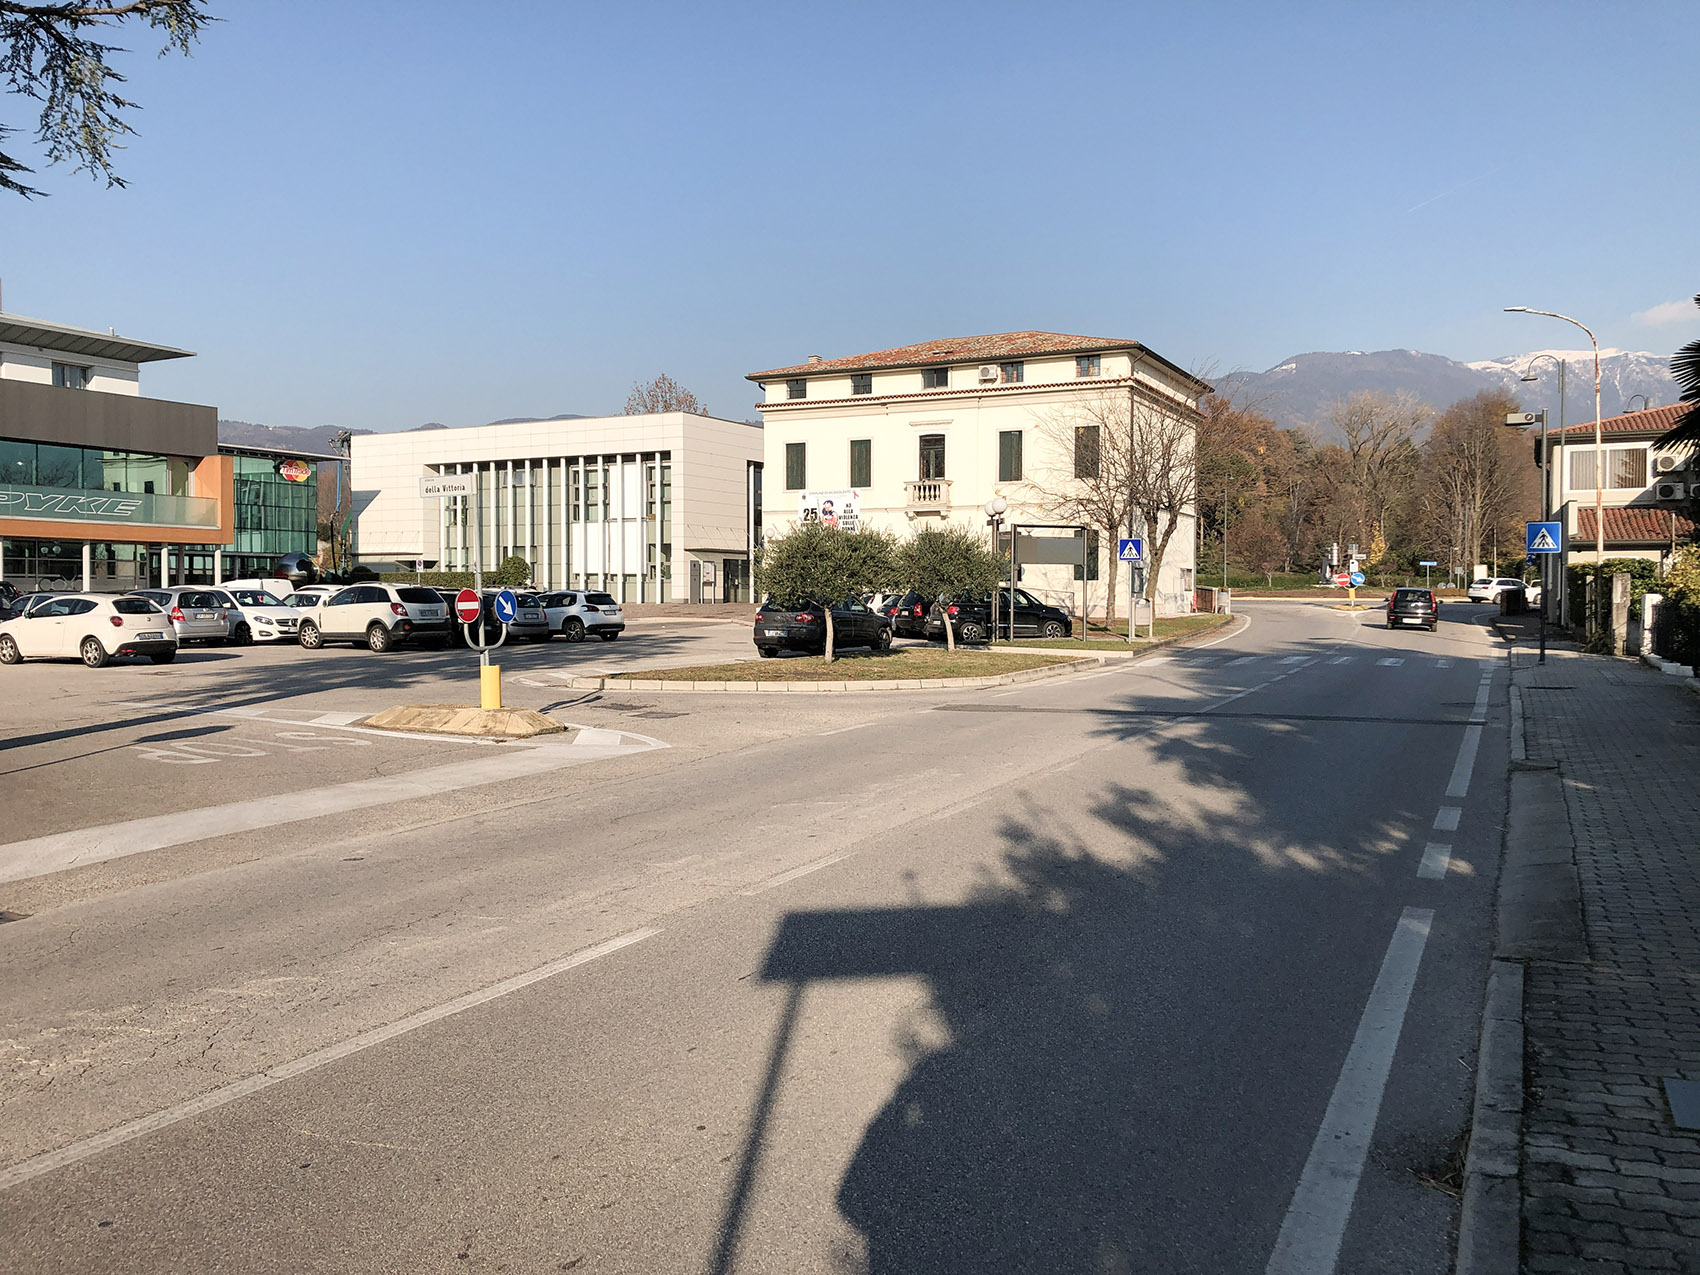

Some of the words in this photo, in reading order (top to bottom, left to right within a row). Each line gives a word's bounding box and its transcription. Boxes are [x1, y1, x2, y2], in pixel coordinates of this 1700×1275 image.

[442, 484, 466, 492] Vittoria
[804, 508, 818, 521] 25
[129, 731, 372, 765] STOP
